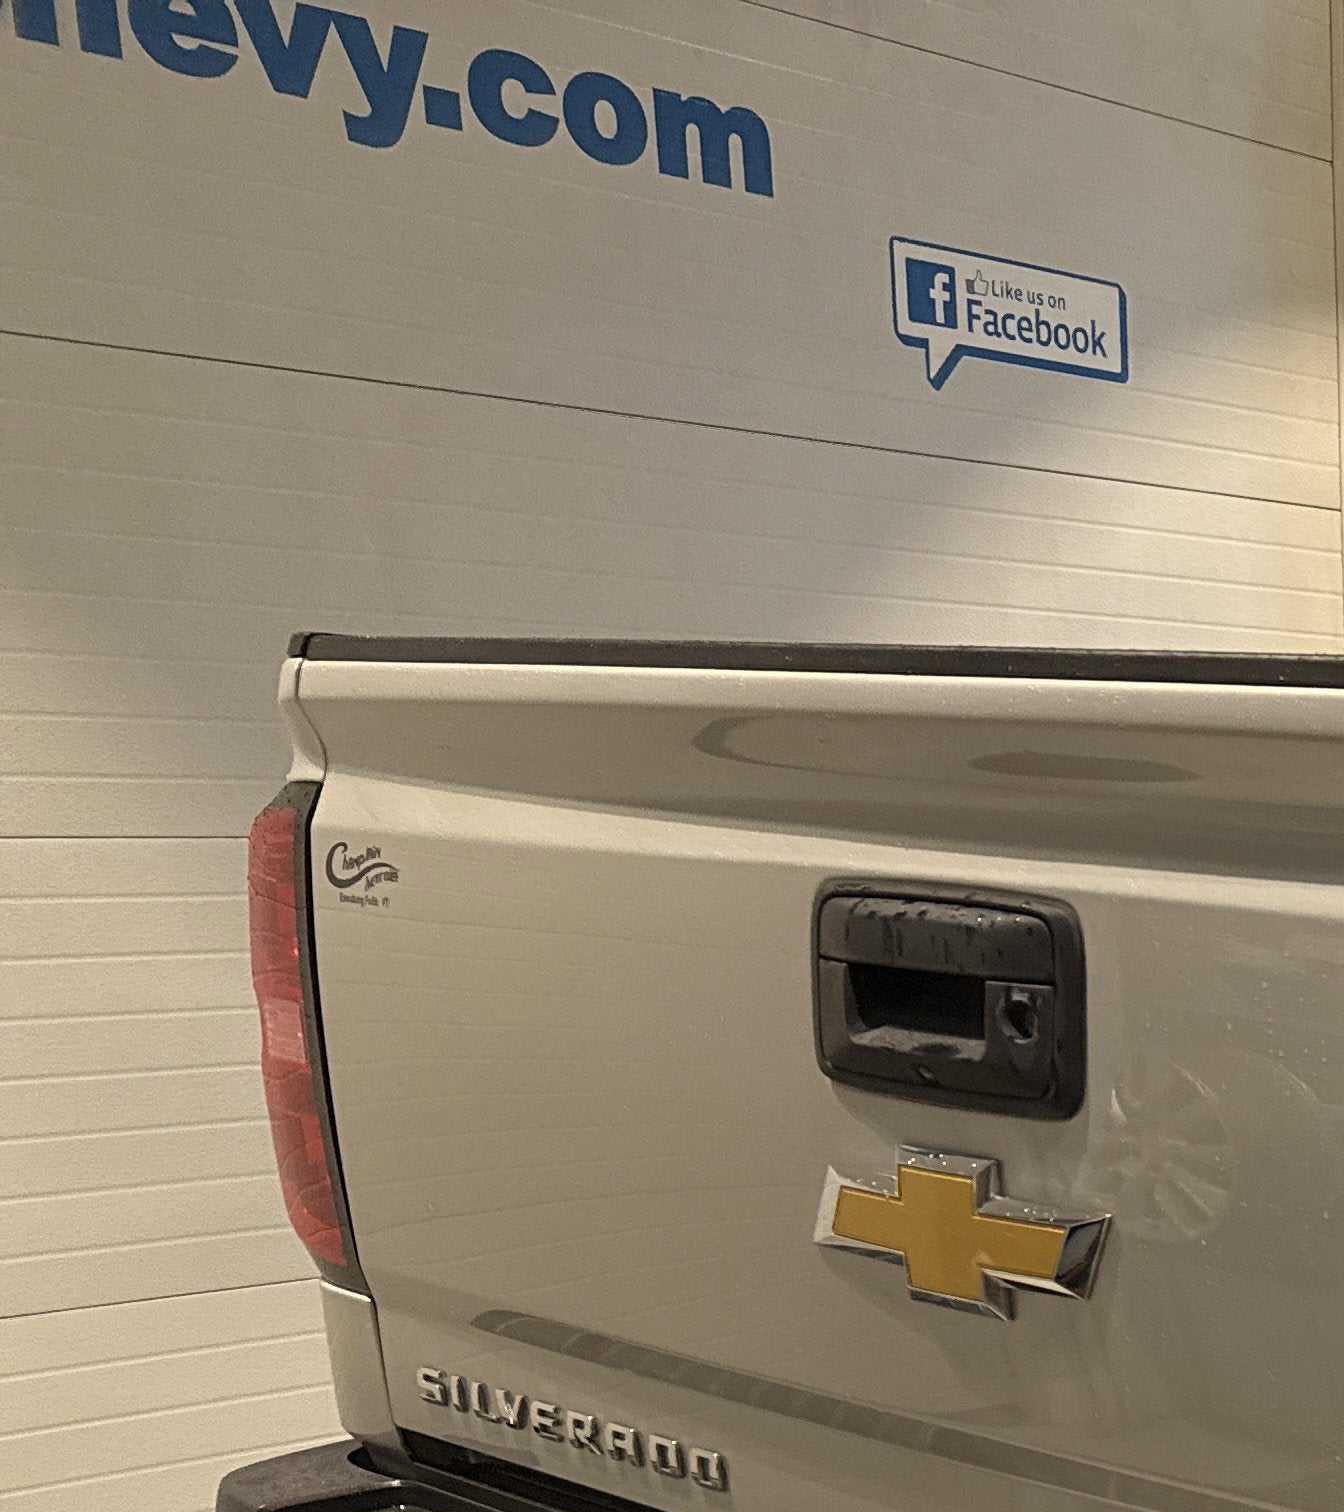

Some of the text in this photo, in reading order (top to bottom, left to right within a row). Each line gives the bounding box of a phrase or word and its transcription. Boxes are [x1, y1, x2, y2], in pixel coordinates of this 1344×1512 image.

[991, 280, 1067, 311] Like us on
[966, 297, 1108, 358] Facebook
[416, 1365, 730, 1492] SILVERADO
